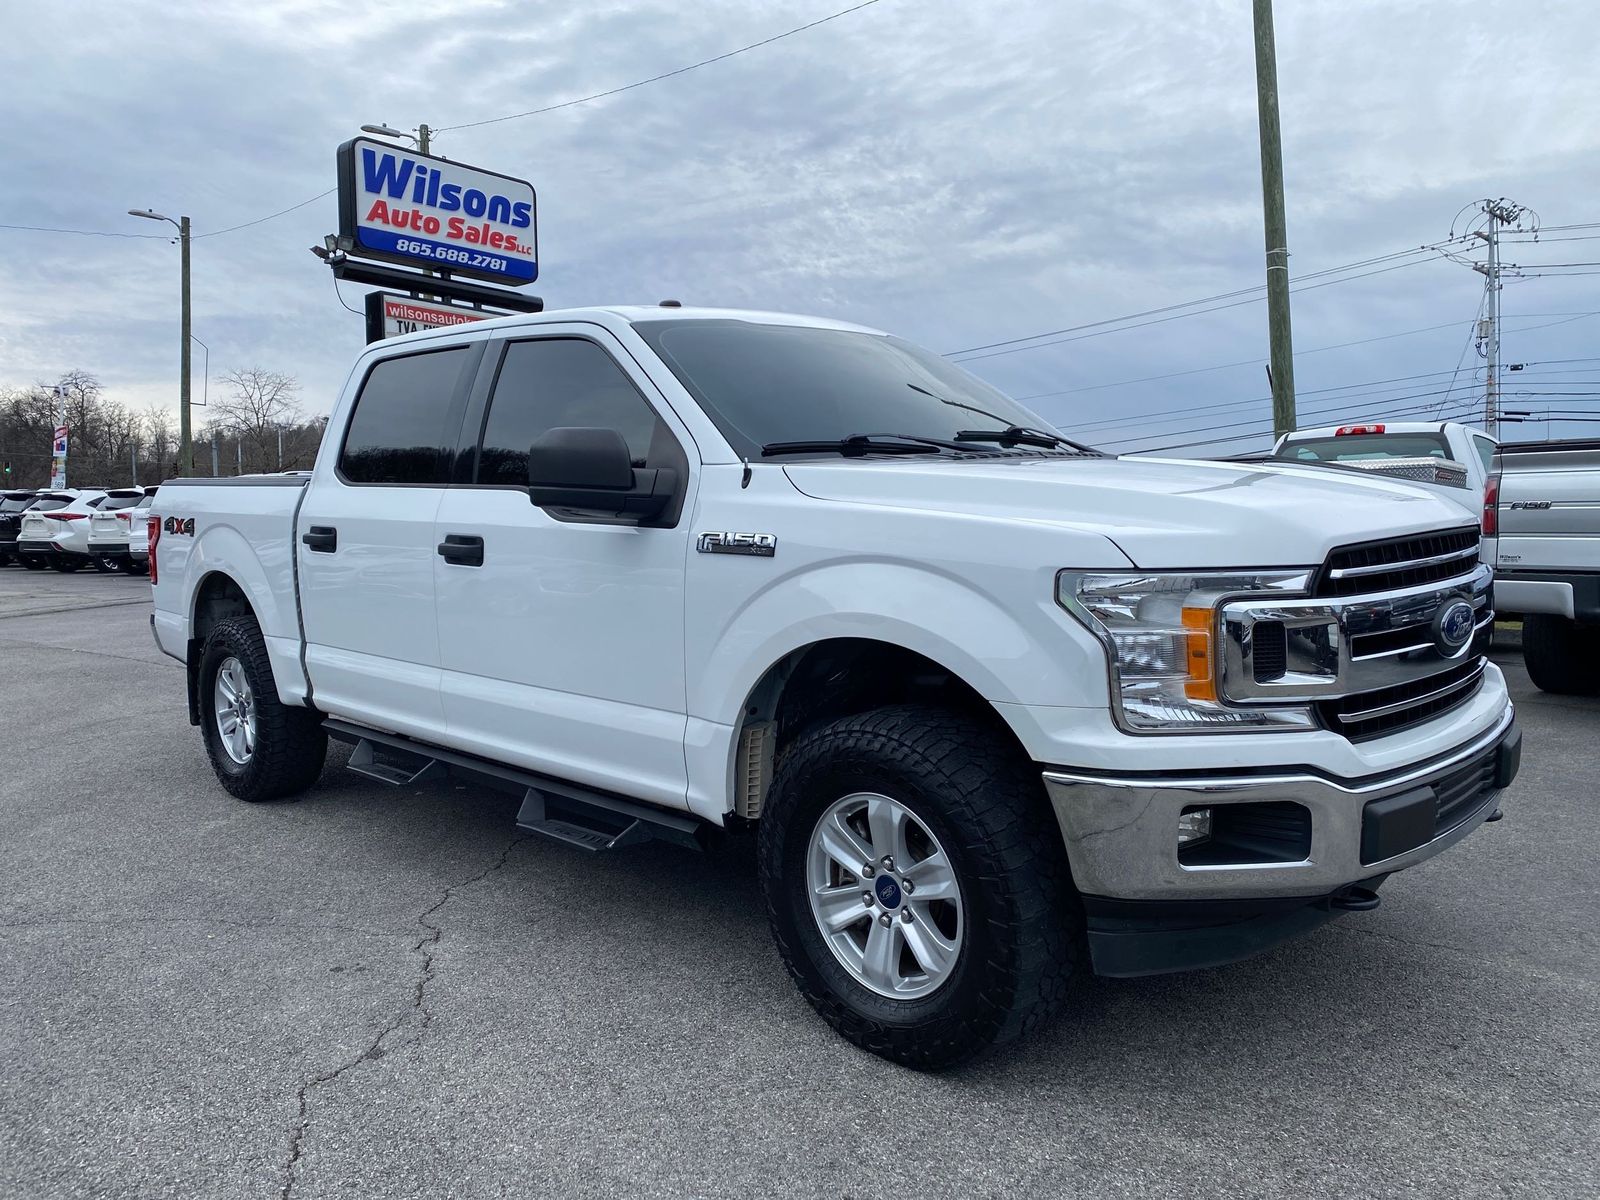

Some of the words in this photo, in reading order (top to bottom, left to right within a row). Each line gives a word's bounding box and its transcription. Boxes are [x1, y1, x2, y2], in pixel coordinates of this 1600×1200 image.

[362, 148, 532, 228] Wilsons
[366, 199, 440, 234] Auto
[446, 216, 517, 251] Sales
[515, 244, 532, 255] LLC
[396, 239, 507, 271] 865.688.2781
[396, 320, 417, 334] TVA
